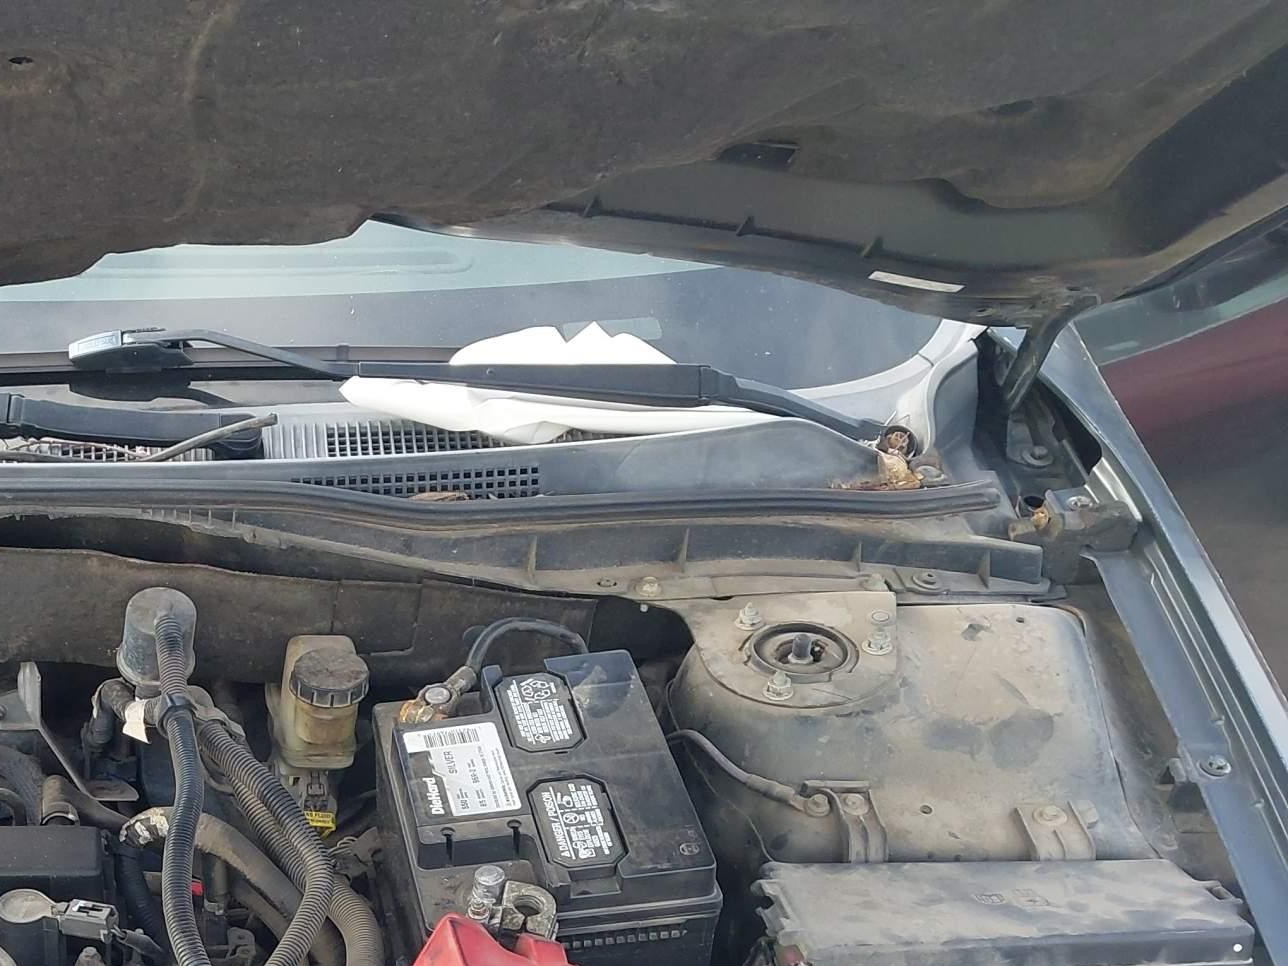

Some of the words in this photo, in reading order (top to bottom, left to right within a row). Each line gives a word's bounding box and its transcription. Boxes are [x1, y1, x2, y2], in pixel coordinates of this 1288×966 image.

[443, 750, 458, 775] SILVER
[422, 777, 445, 815] DieHard
[541, 791, 558, 817] POISON
[551, 822, 569, 851] DANGER
